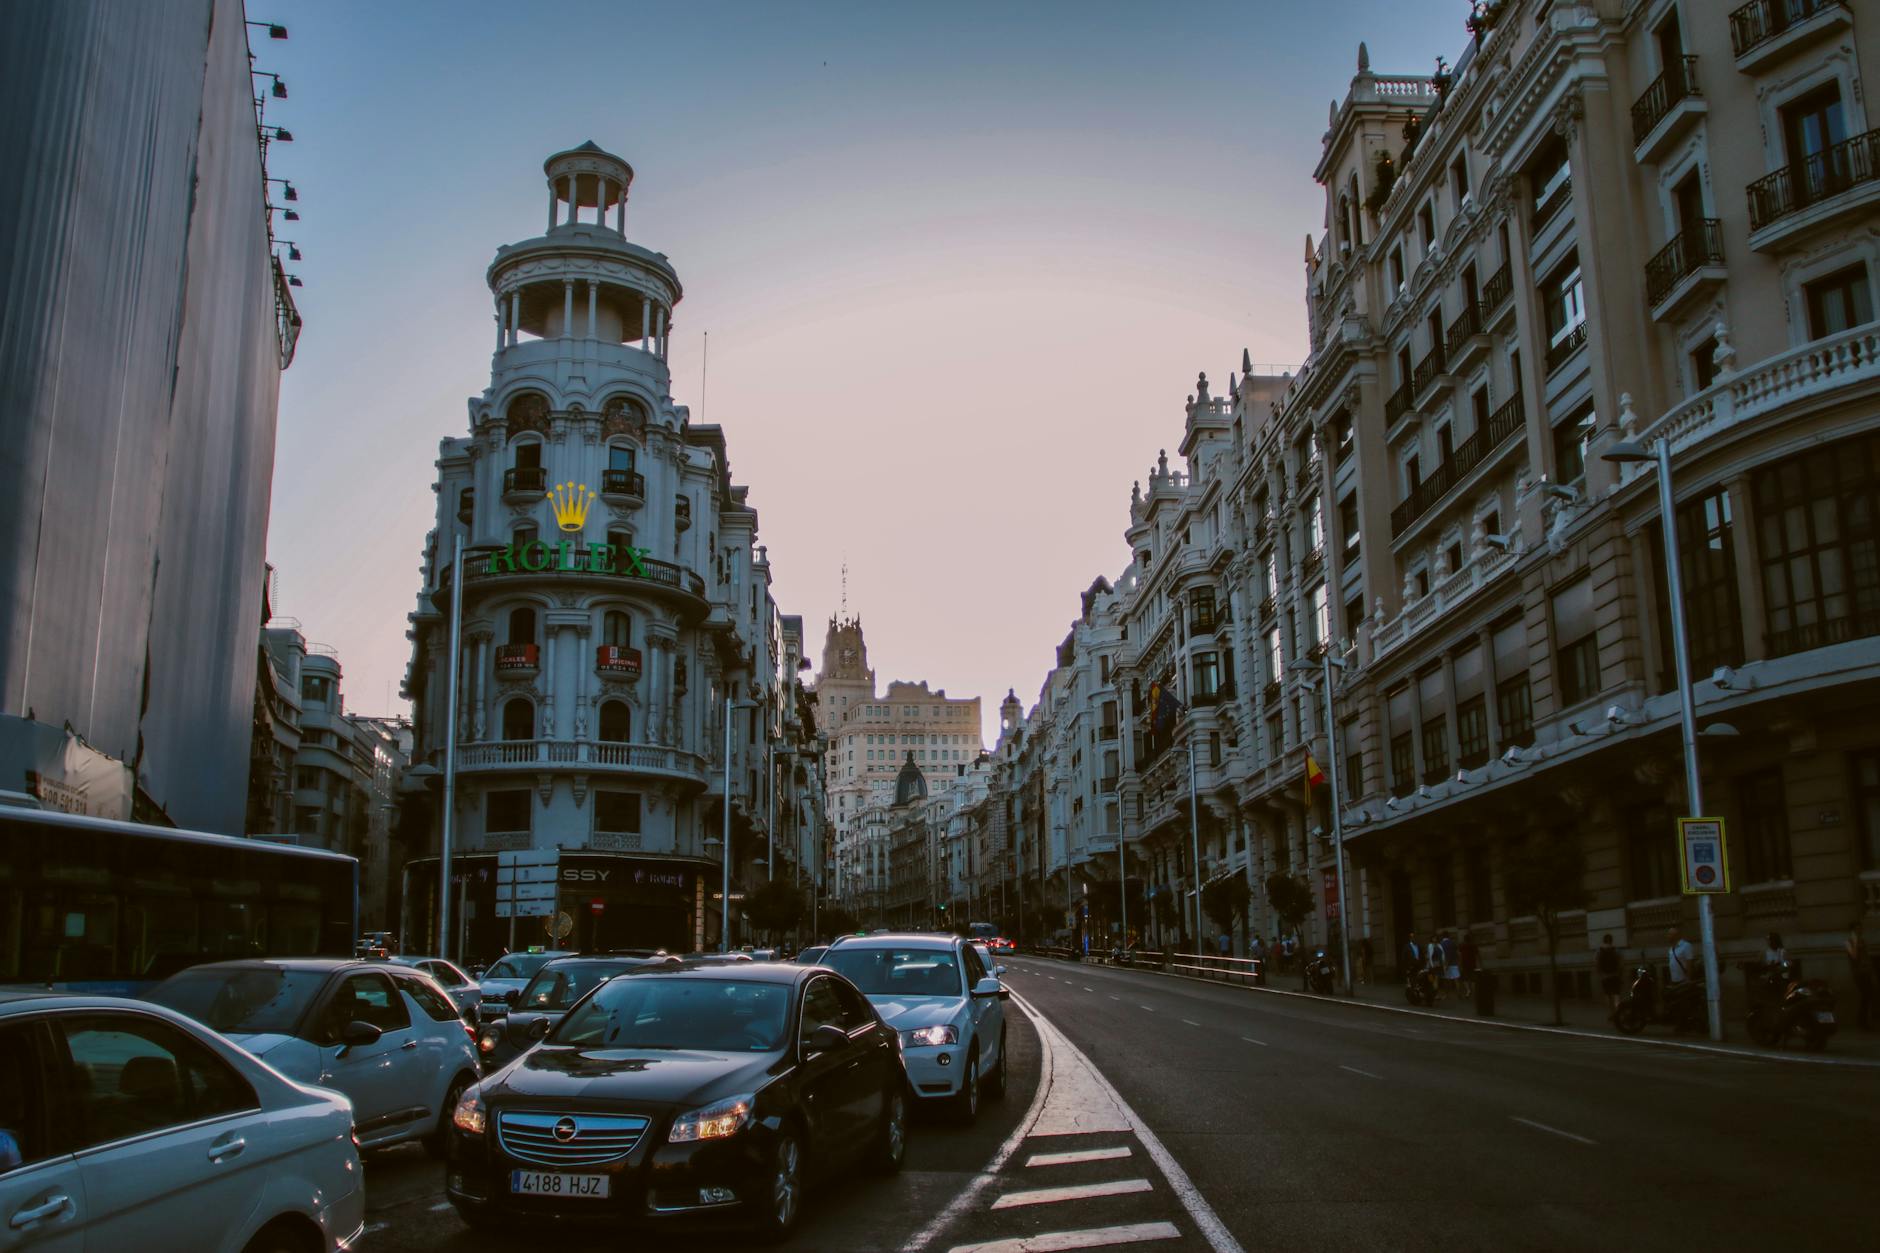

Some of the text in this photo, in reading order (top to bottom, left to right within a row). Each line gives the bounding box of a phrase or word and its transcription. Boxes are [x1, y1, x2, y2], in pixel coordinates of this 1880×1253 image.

[488, 540, 651, 577] ROLEX
[560, 869, 611, 881] SSY
[523, 1173, 601, 1195] 4188 HJZ
